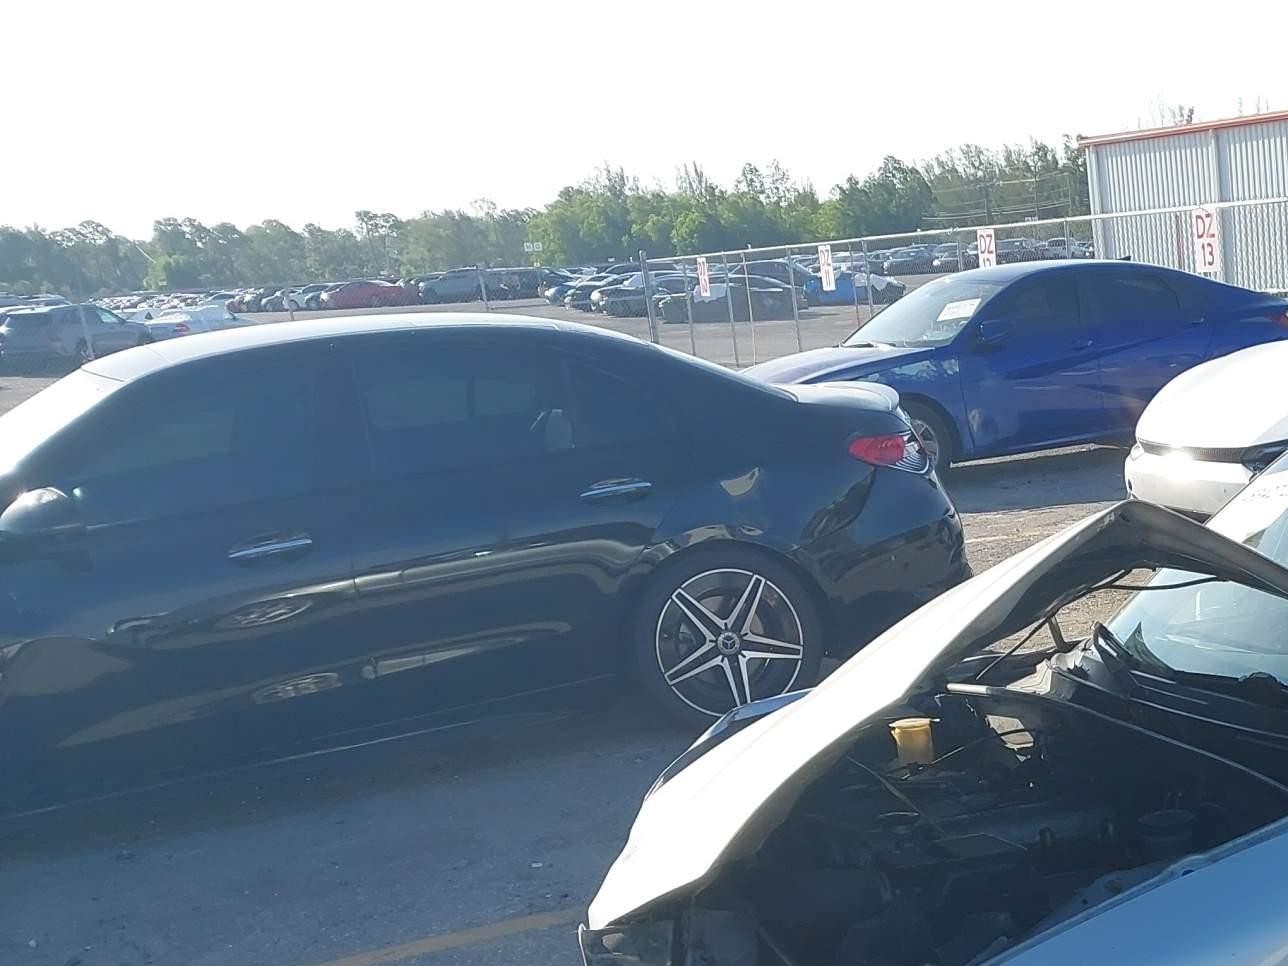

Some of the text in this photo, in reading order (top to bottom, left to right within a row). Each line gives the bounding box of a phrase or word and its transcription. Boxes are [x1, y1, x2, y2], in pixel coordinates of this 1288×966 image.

[1195, 213, 1216, 239] DZ
[979, 233, 994, 254] DZ
[1201, 242, 1215, 267] 13
